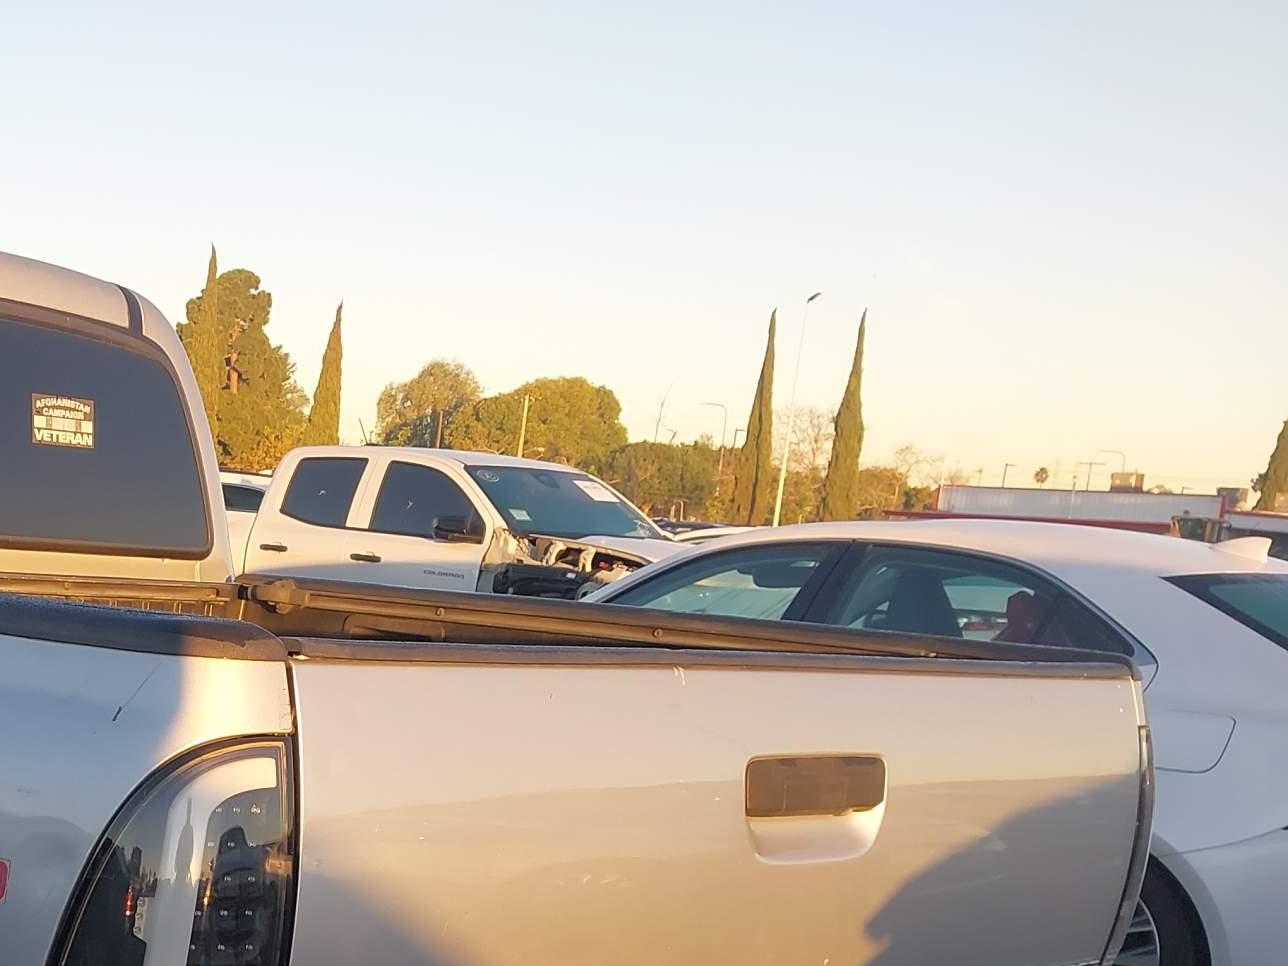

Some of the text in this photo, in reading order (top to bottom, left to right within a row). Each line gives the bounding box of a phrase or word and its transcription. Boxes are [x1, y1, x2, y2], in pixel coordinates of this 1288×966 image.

[35, 398, 90, 413] AFGHANISTAN
[42, 408, 84, 419] CAMPAIGN
[34, 429, 93, 445] VETERAN
